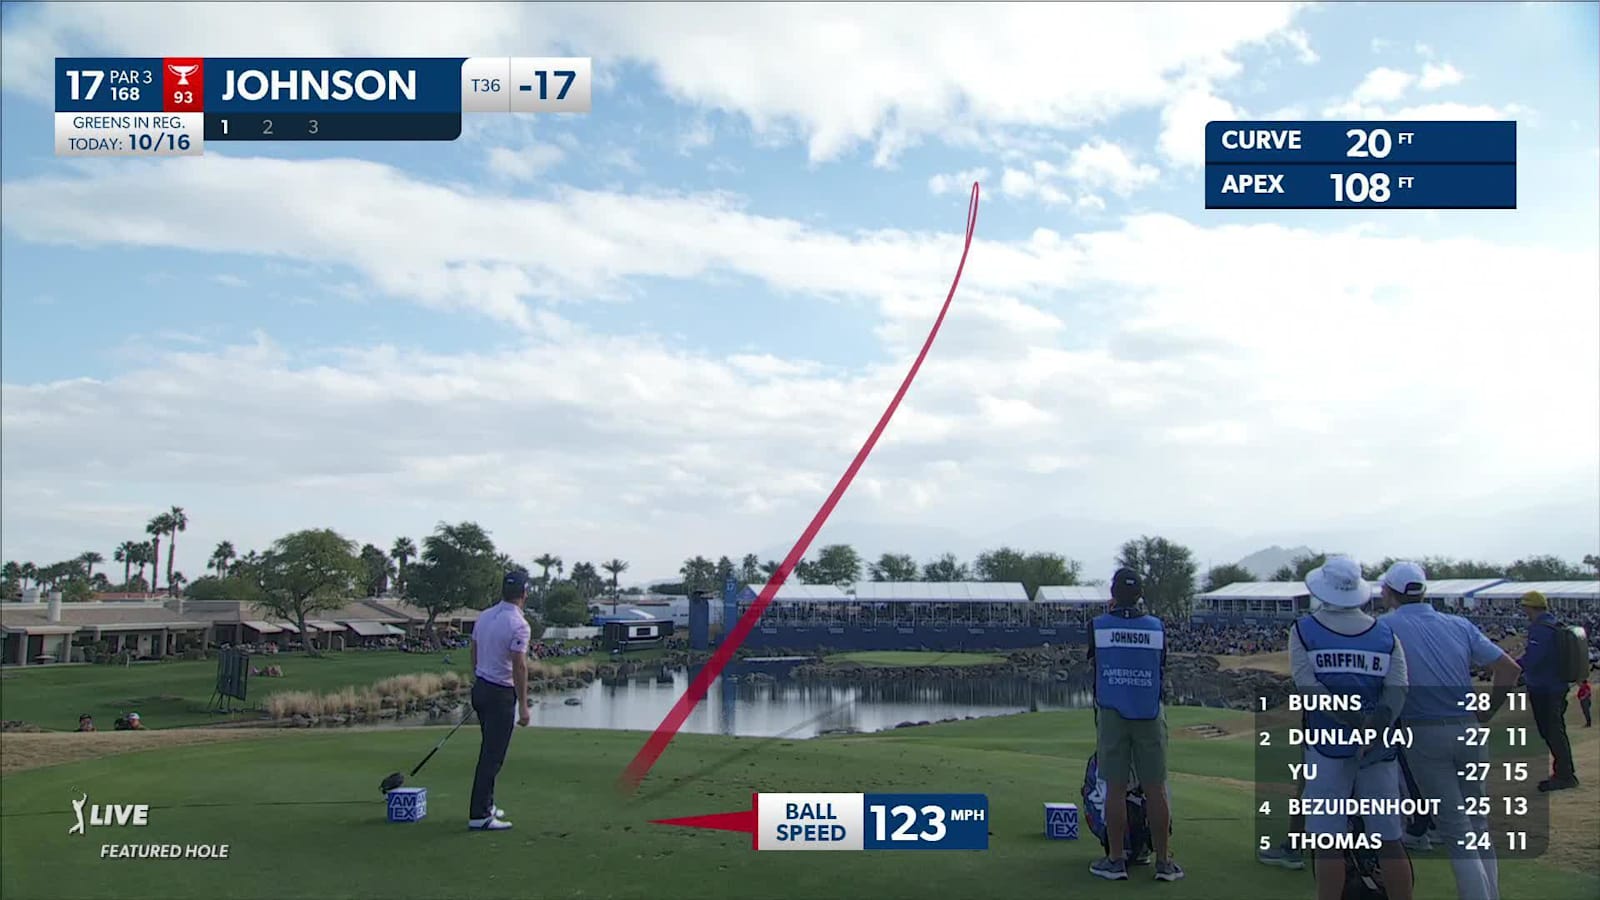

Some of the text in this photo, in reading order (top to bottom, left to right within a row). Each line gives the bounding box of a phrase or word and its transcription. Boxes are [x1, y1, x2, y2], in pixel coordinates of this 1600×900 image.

[1110, 631, 1150, 645] JOHNSON
[1316, 653, 1382, 672] GRIFFIN, B.
[1103, 668, 1152, 678] AMERICAN
[1108, 677, 1152, 687] EXPRESS
[391, 795, 416, 807] AM
[394, 807, 416, 819] EX
[1051, 811, 1078, 823] AM
[1054, 823, 1078, 836] EX
